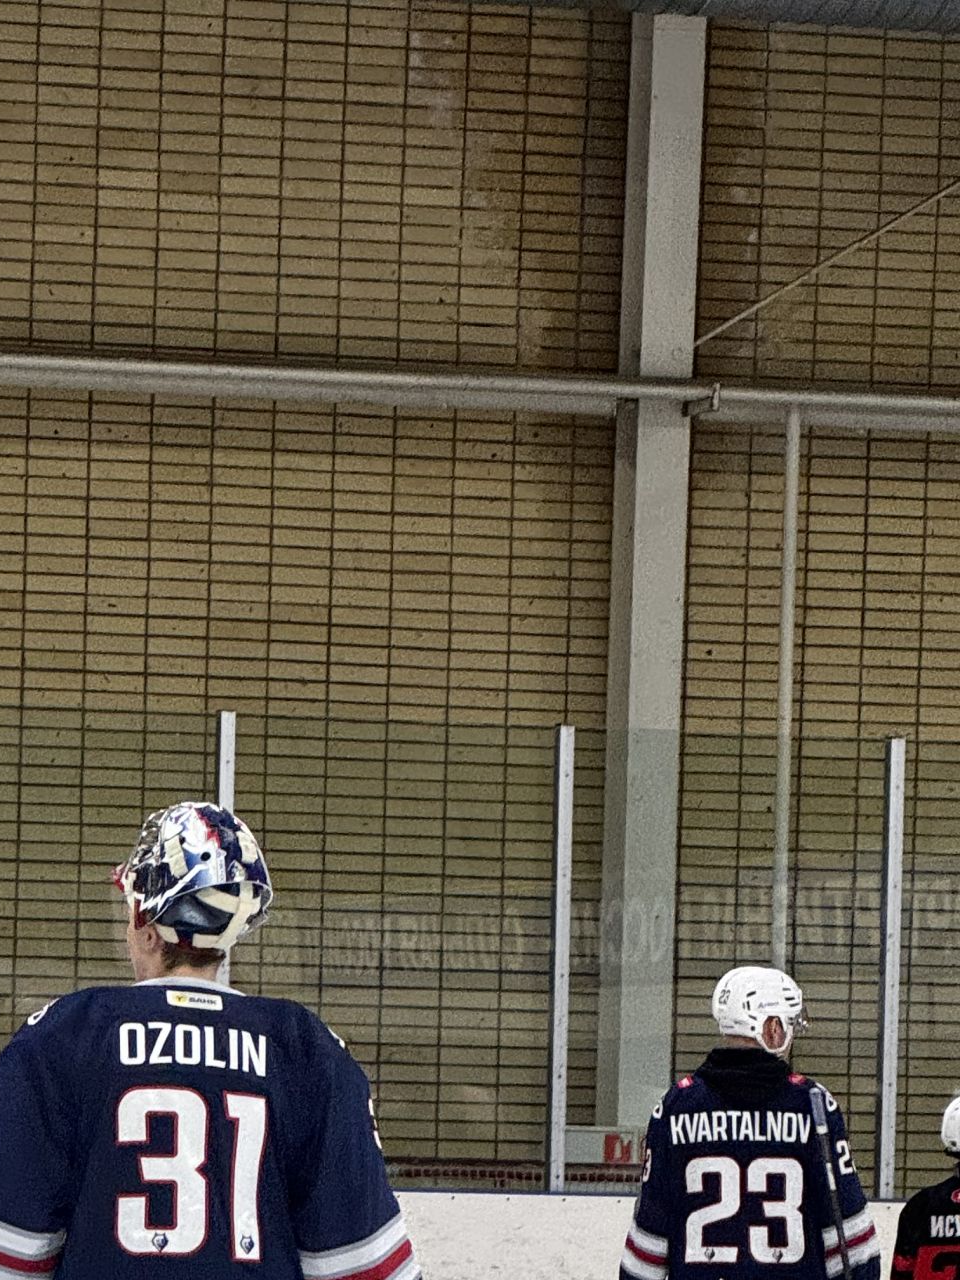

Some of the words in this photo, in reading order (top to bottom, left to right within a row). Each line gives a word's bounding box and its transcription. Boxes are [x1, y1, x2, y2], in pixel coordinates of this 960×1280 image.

[119, 1021, 267, 1077] OZOLIN
[669, 1109, 812, 1145] KVARTALNOV
[117, 1085, 267, 1262] 31
[684, 1156, 805, 1264] 23
